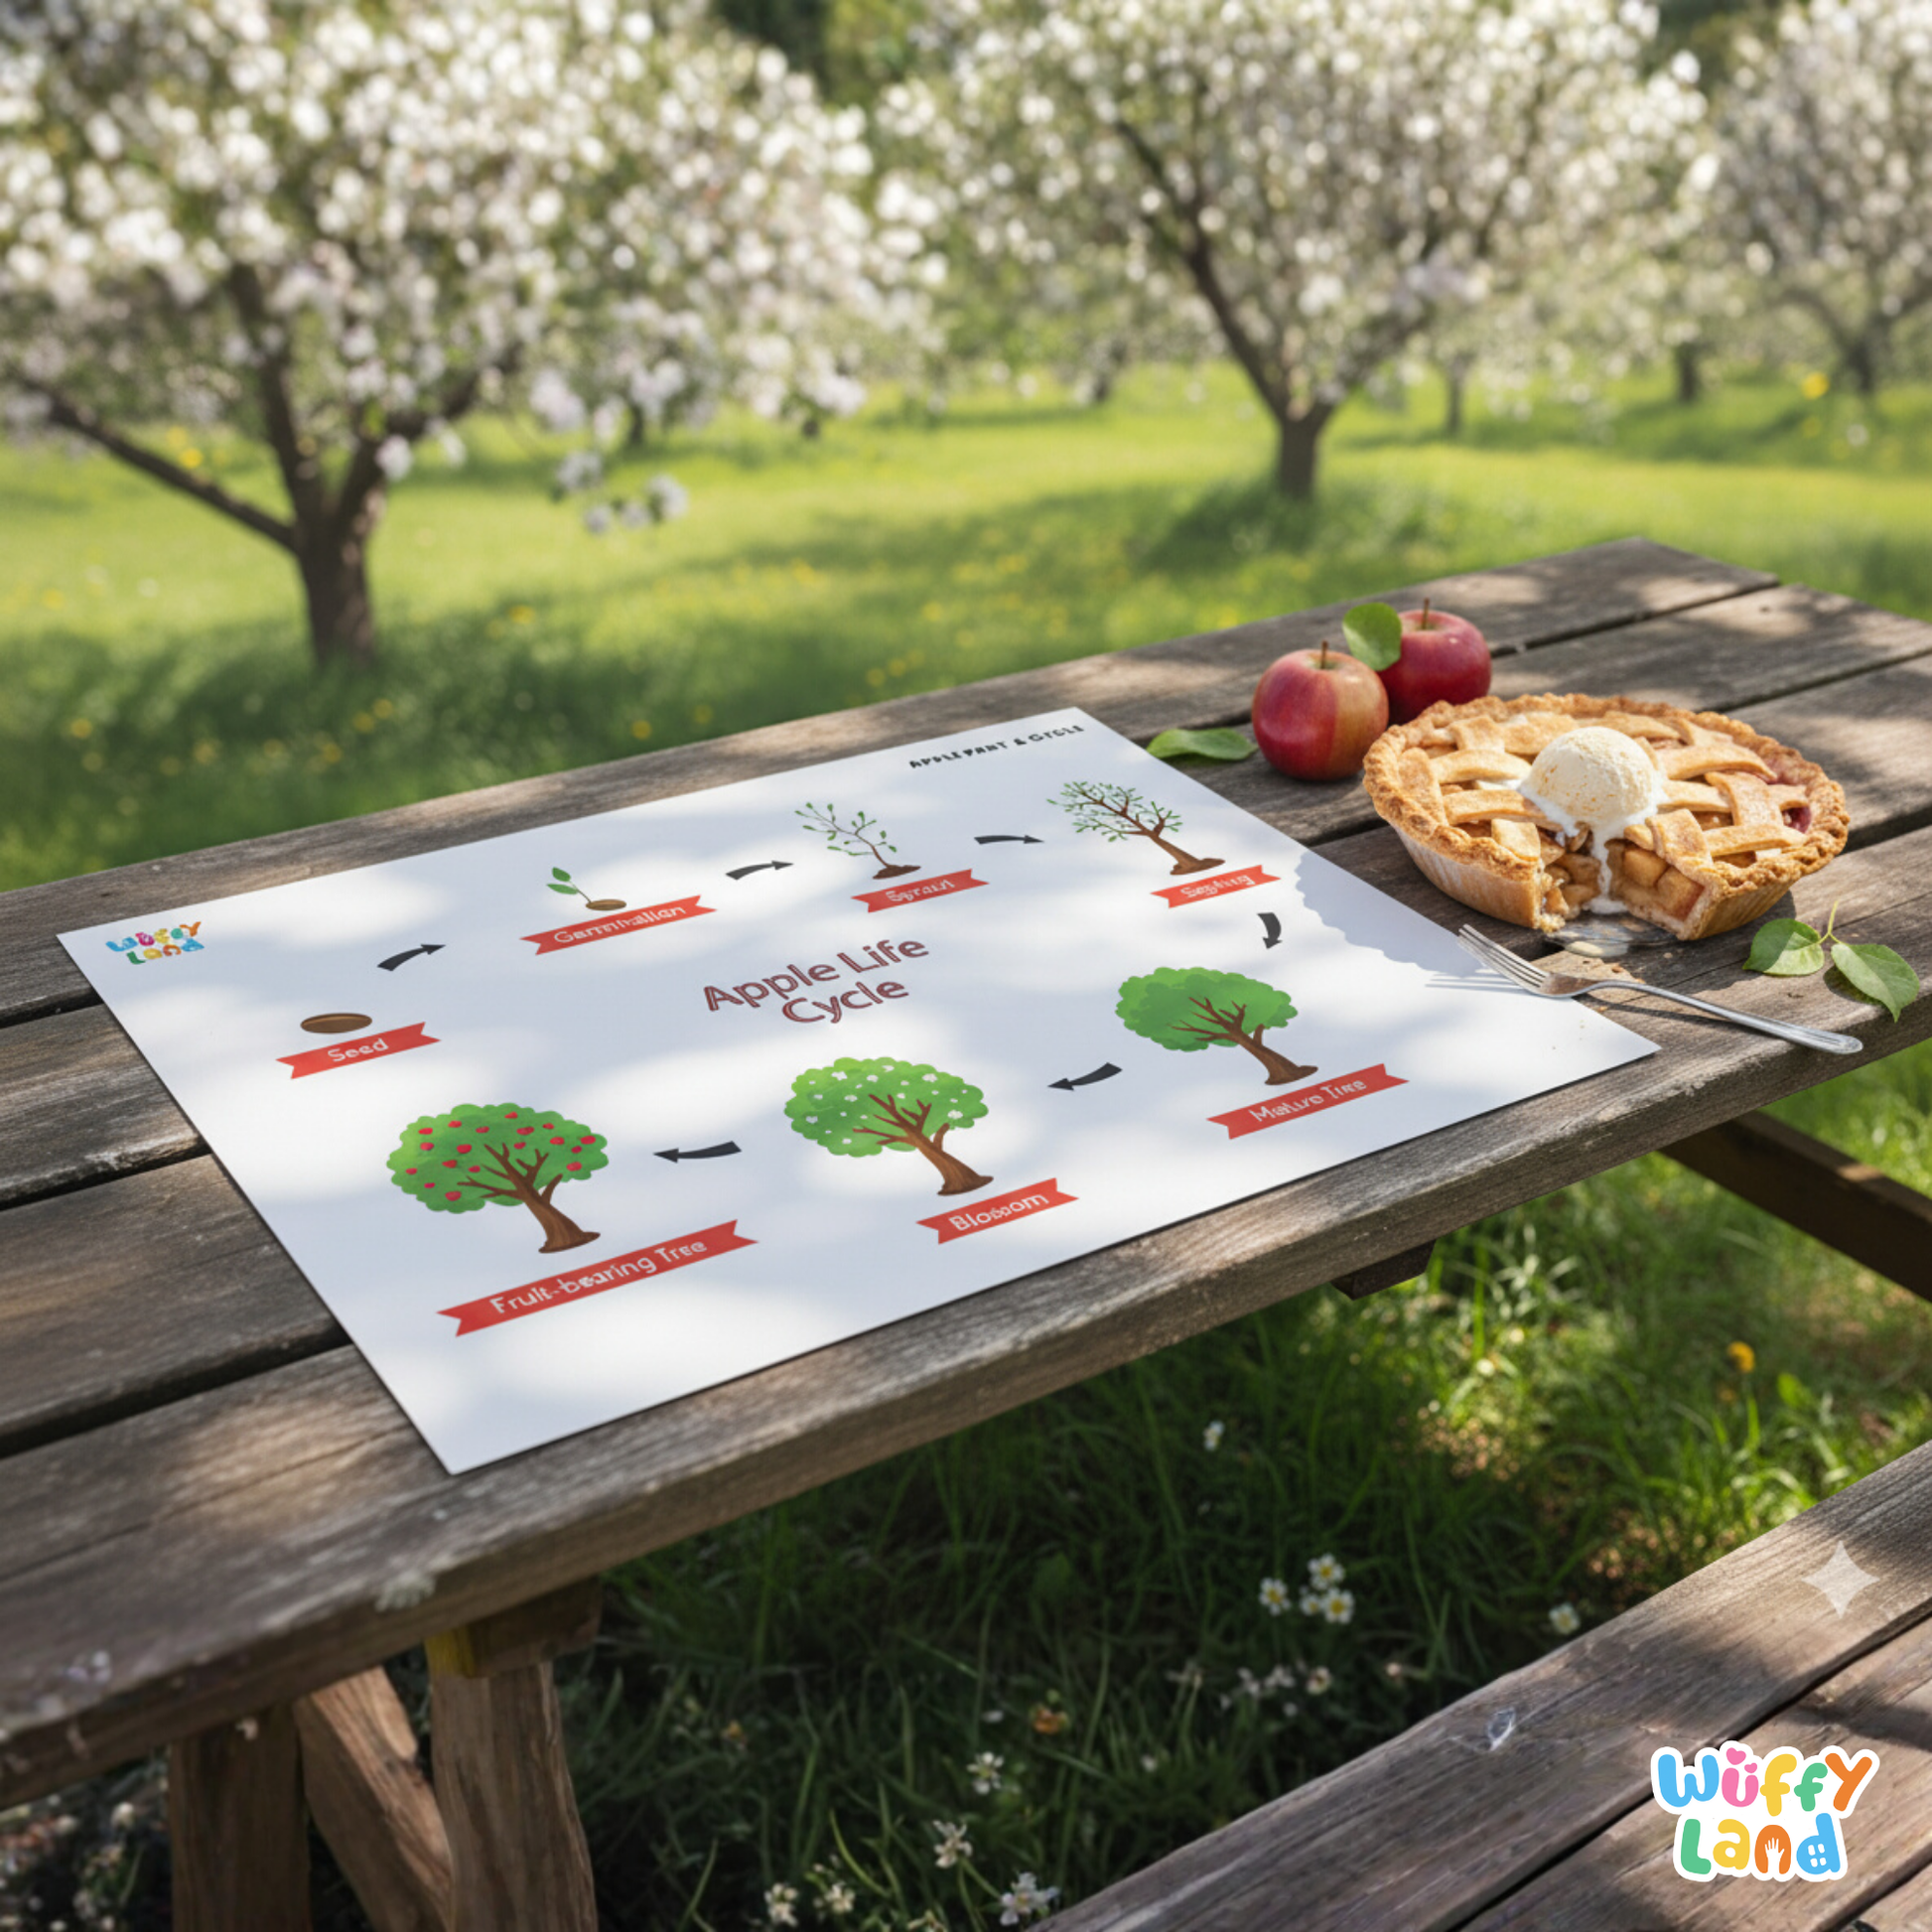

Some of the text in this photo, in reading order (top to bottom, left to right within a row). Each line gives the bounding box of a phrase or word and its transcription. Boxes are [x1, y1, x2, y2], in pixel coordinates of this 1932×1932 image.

[703, 939, 929, 1012] Apple Life
[781, 981, 909, 1024] Cycle
[327, 1037, 389, 1062] Seed
[489, 1240, 708, 1313] Fruit-bearing Tree
